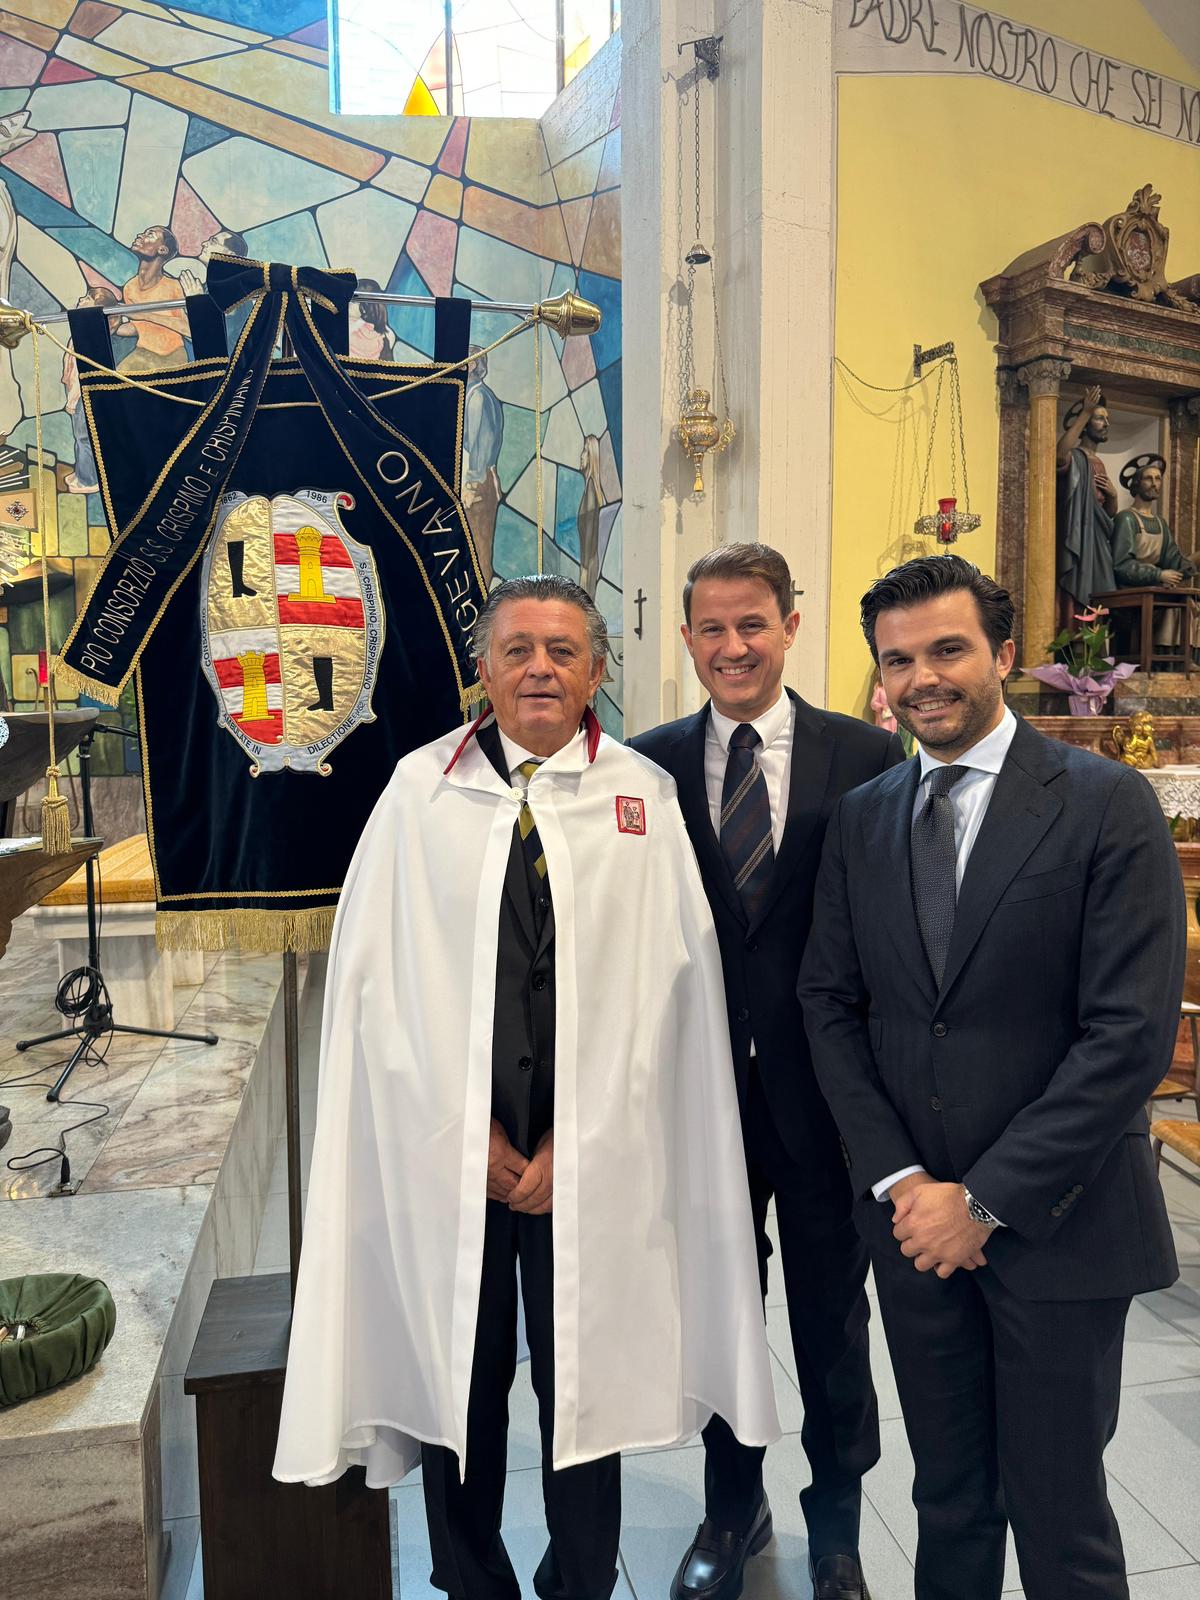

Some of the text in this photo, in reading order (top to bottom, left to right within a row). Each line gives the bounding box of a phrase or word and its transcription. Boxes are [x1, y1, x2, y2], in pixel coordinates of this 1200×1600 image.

[954, 4, 1058, 93] NOSTRO
[1070, 51, 1121, 118] CHE
[1131, 70, 1162, 129] SEI
[200, 463, 219, 477] E
[156, 476, 211, 540] CRISPINO
[306, 490, 328, 504] 1986
[93, 557, 156, 644] CONSORZIO
[363, 576, 377, 623] CRISPINO
[80, 643, 113, 675] PIO
[364, 629, 378, 690] CRISPINIANO
[224, 713, 355, 755] AMBULATE IN DILECTIONE
